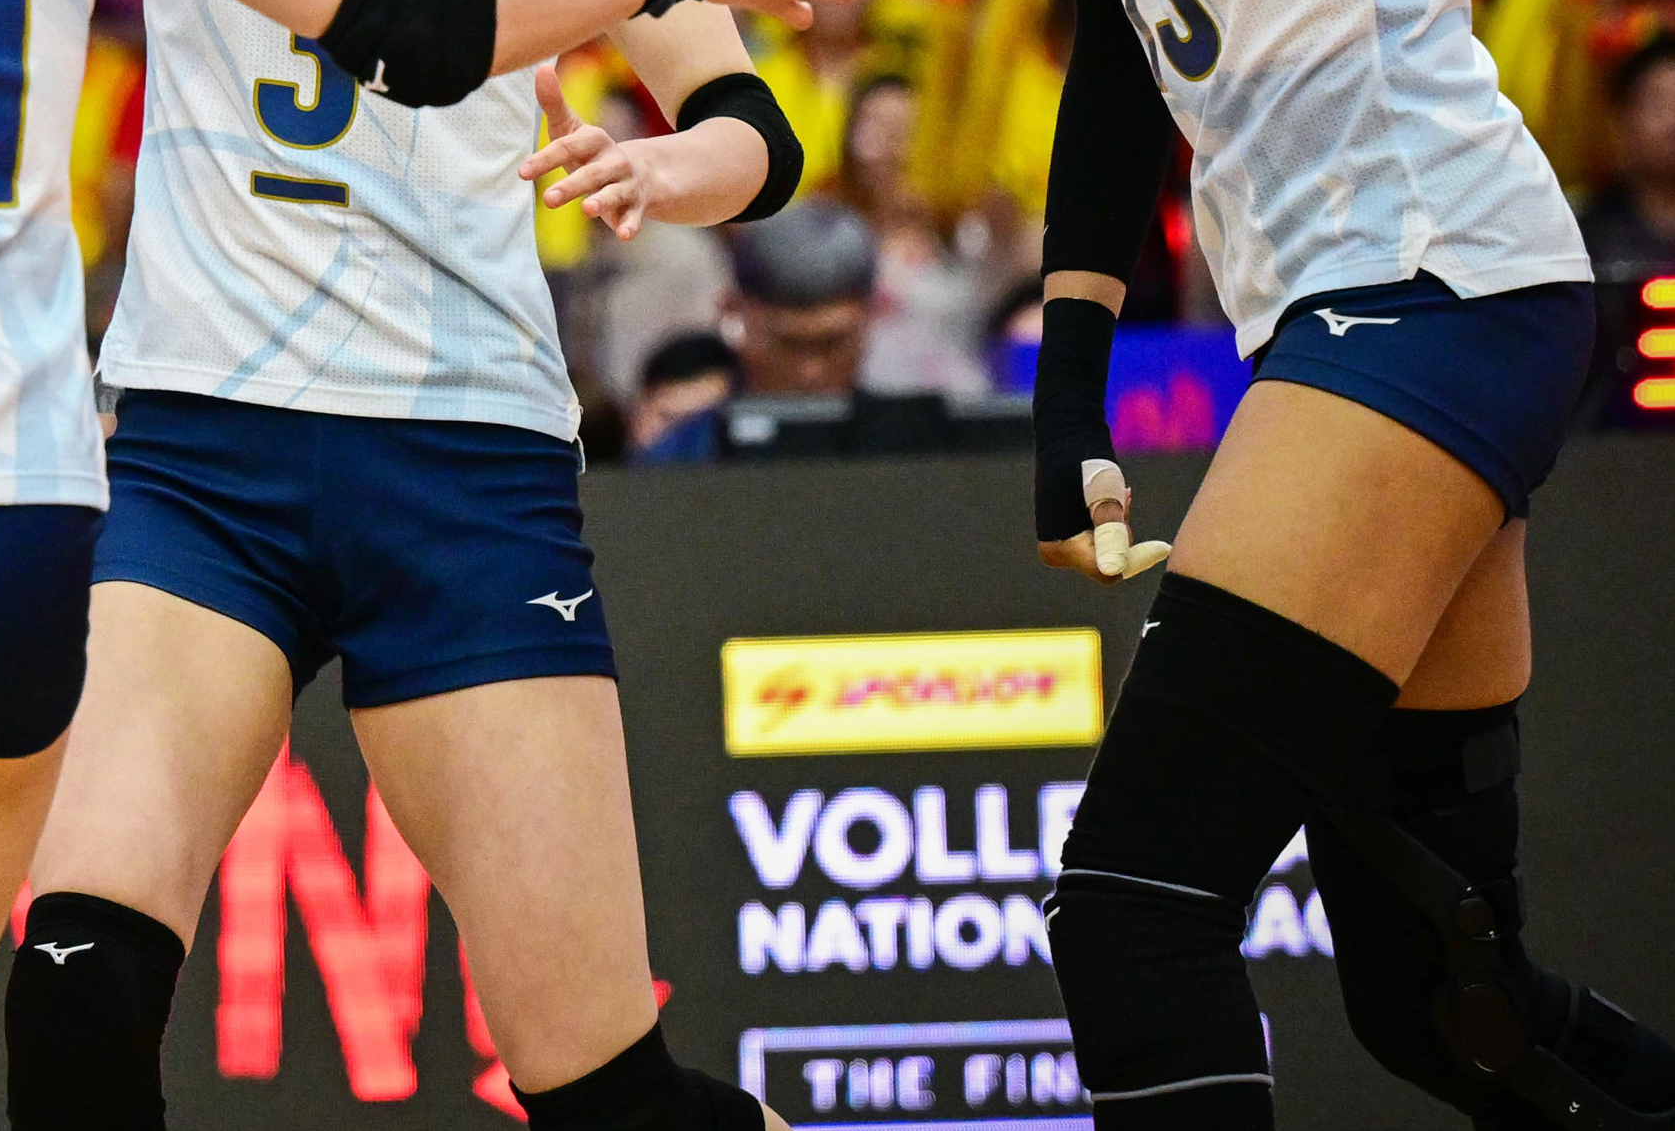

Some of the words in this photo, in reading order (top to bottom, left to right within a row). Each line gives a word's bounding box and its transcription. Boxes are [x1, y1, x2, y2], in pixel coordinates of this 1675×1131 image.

[728, 781, 1090, 890] VOLLE
[738, 891, 1054, 976] NATION
[803, 1055, 937, 1112] THE
[963, 1051, 1092, 1111] FIN
